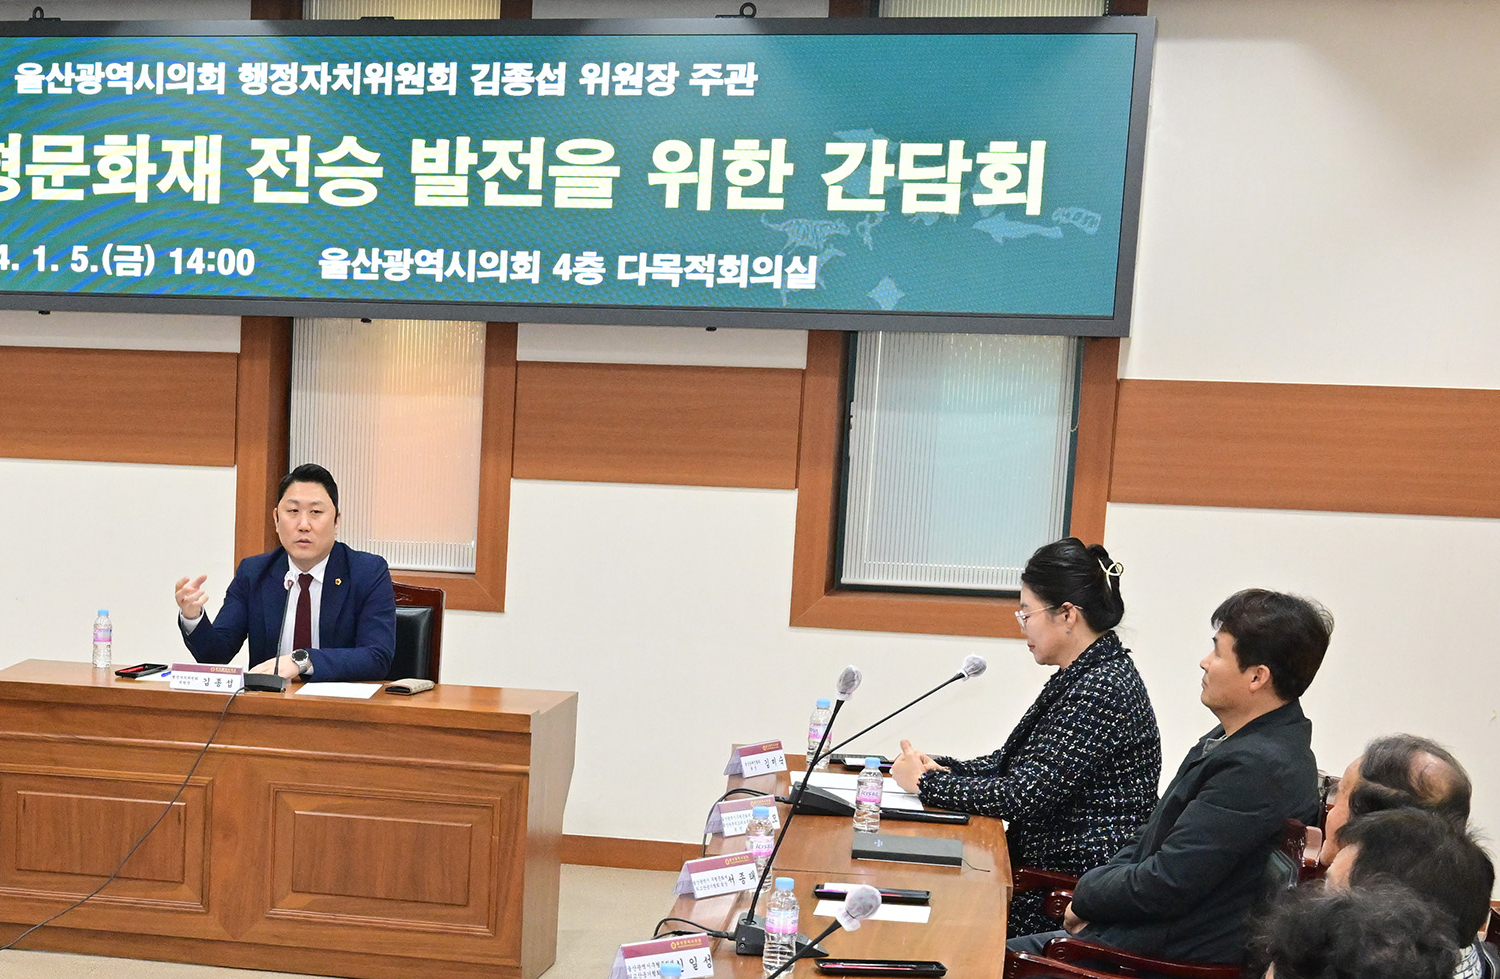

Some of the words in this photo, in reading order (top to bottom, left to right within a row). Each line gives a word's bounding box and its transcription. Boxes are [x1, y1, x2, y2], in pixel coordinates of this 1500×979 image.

[14, 62, 226, 96] 울산광역시의회
[238, 62, 458, 97] 행정자치위원회
[471, 62, 567, 97] 김종섭
[579, 62, 681, 98] 위원장
[689, 62, 759, 98] 주관
[246, 135, 384, 208] 전승
[411, 136, 621, 210] 발전을
[647, 138, 795, 212] 위한
[821, 139, 1047, 216] 간담회
[34, 246, 60, 272] 1.
[72, 244, 156, 278] 5.(금)
[171, 247, 256, 277] 14:00
[319, 248, 541, 286] 울산광역시의회
[553, 252, 607, 286] 4층
[618, 253, 818, 291] 다목적회의실
